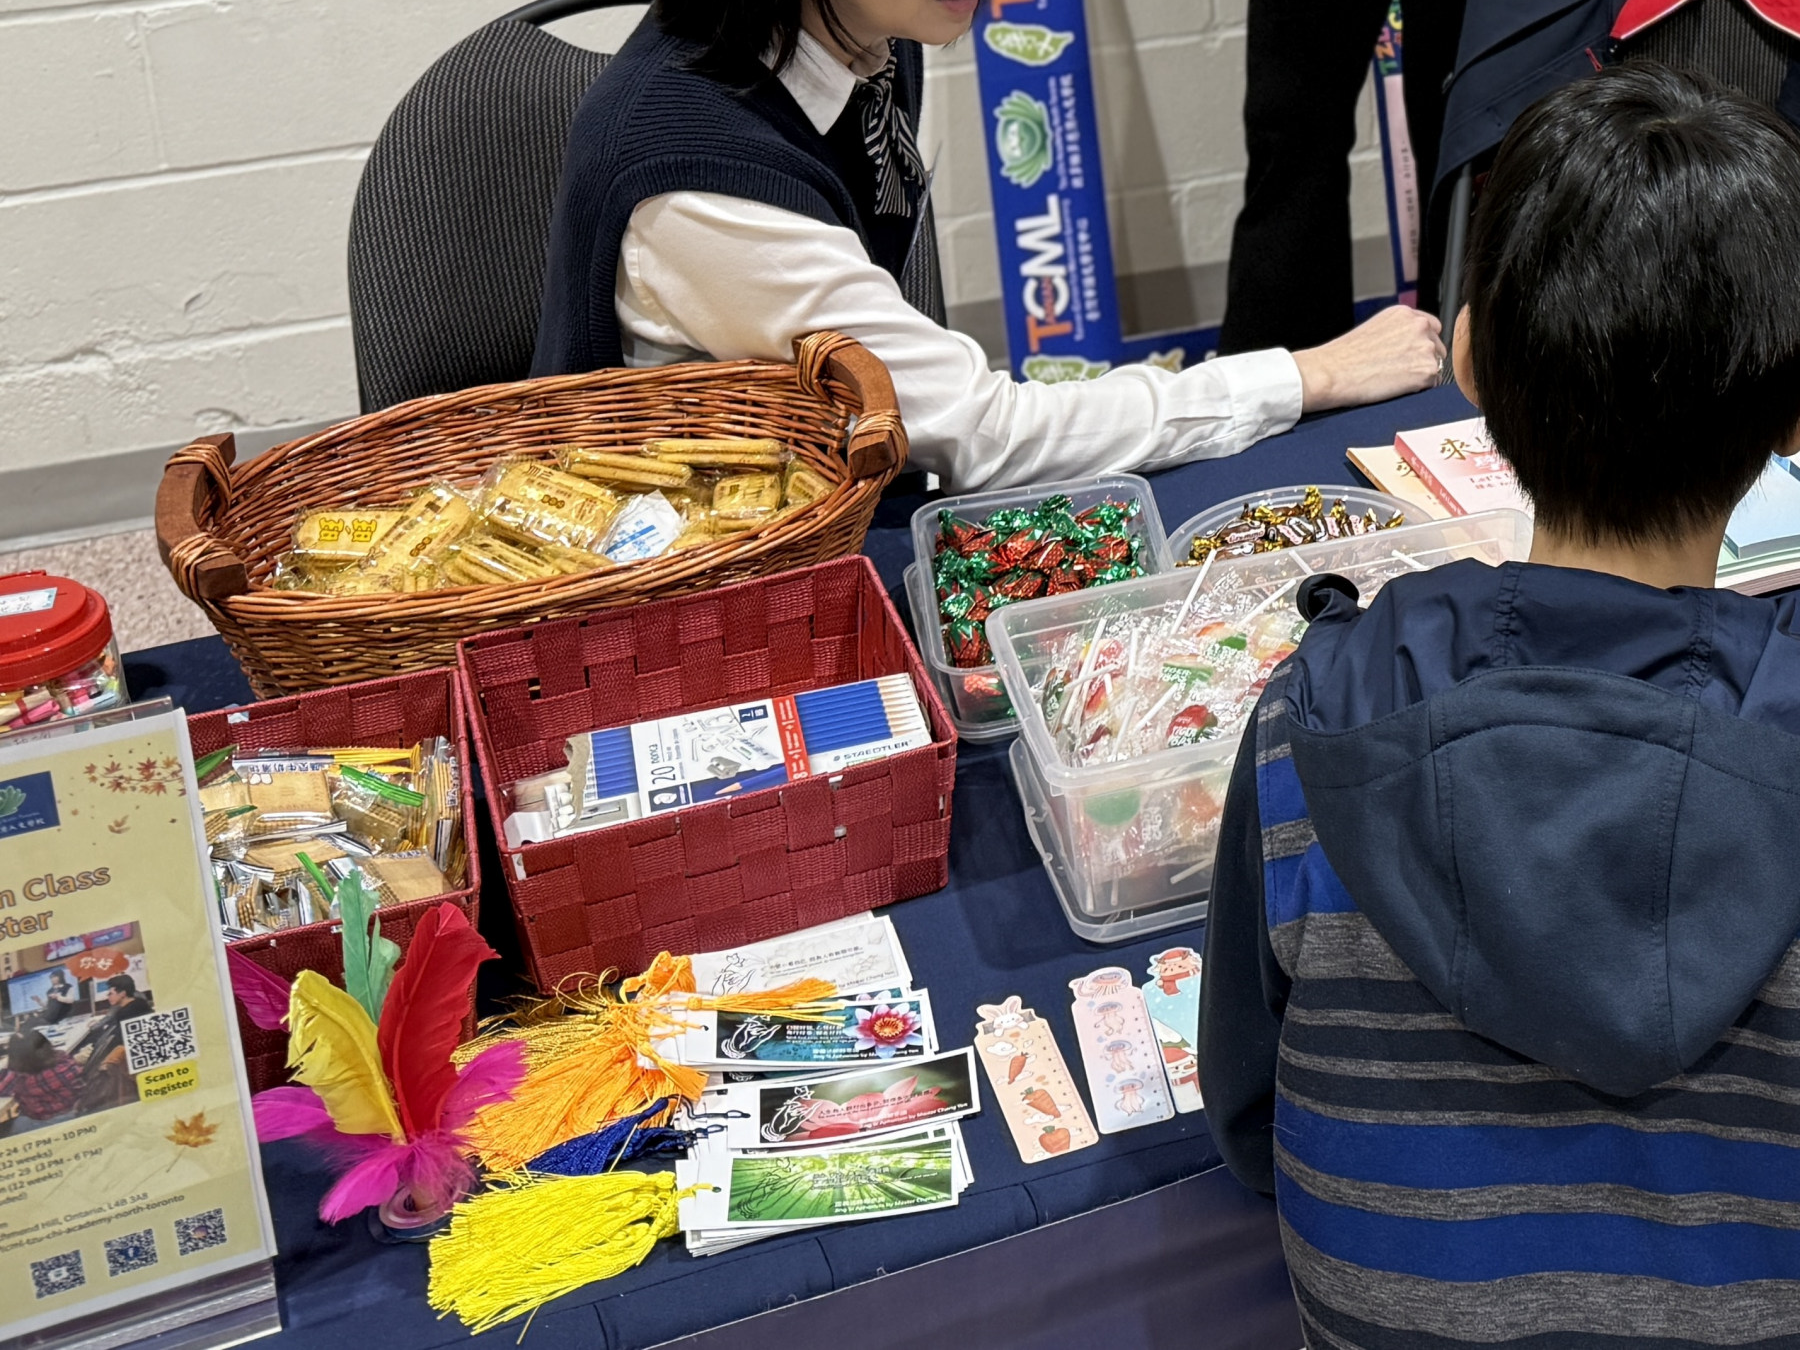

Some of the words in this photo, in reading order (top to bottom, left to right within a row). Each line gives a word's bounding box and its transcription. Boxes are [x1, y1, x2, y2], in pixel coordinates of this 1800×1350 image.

[1015, 195, 1073, 353] TCML
[844, 741, 908, 760] STAEDTLER
[651, 765, 676, 785] 20
[23, 867, 111, 902] Class
[145, 1069, 174, 1085] Scan
[177, 1065, 190, 1077] to
[144, 1077, 195, 1098] Register
[36, 1137, 52, 1150] PM
